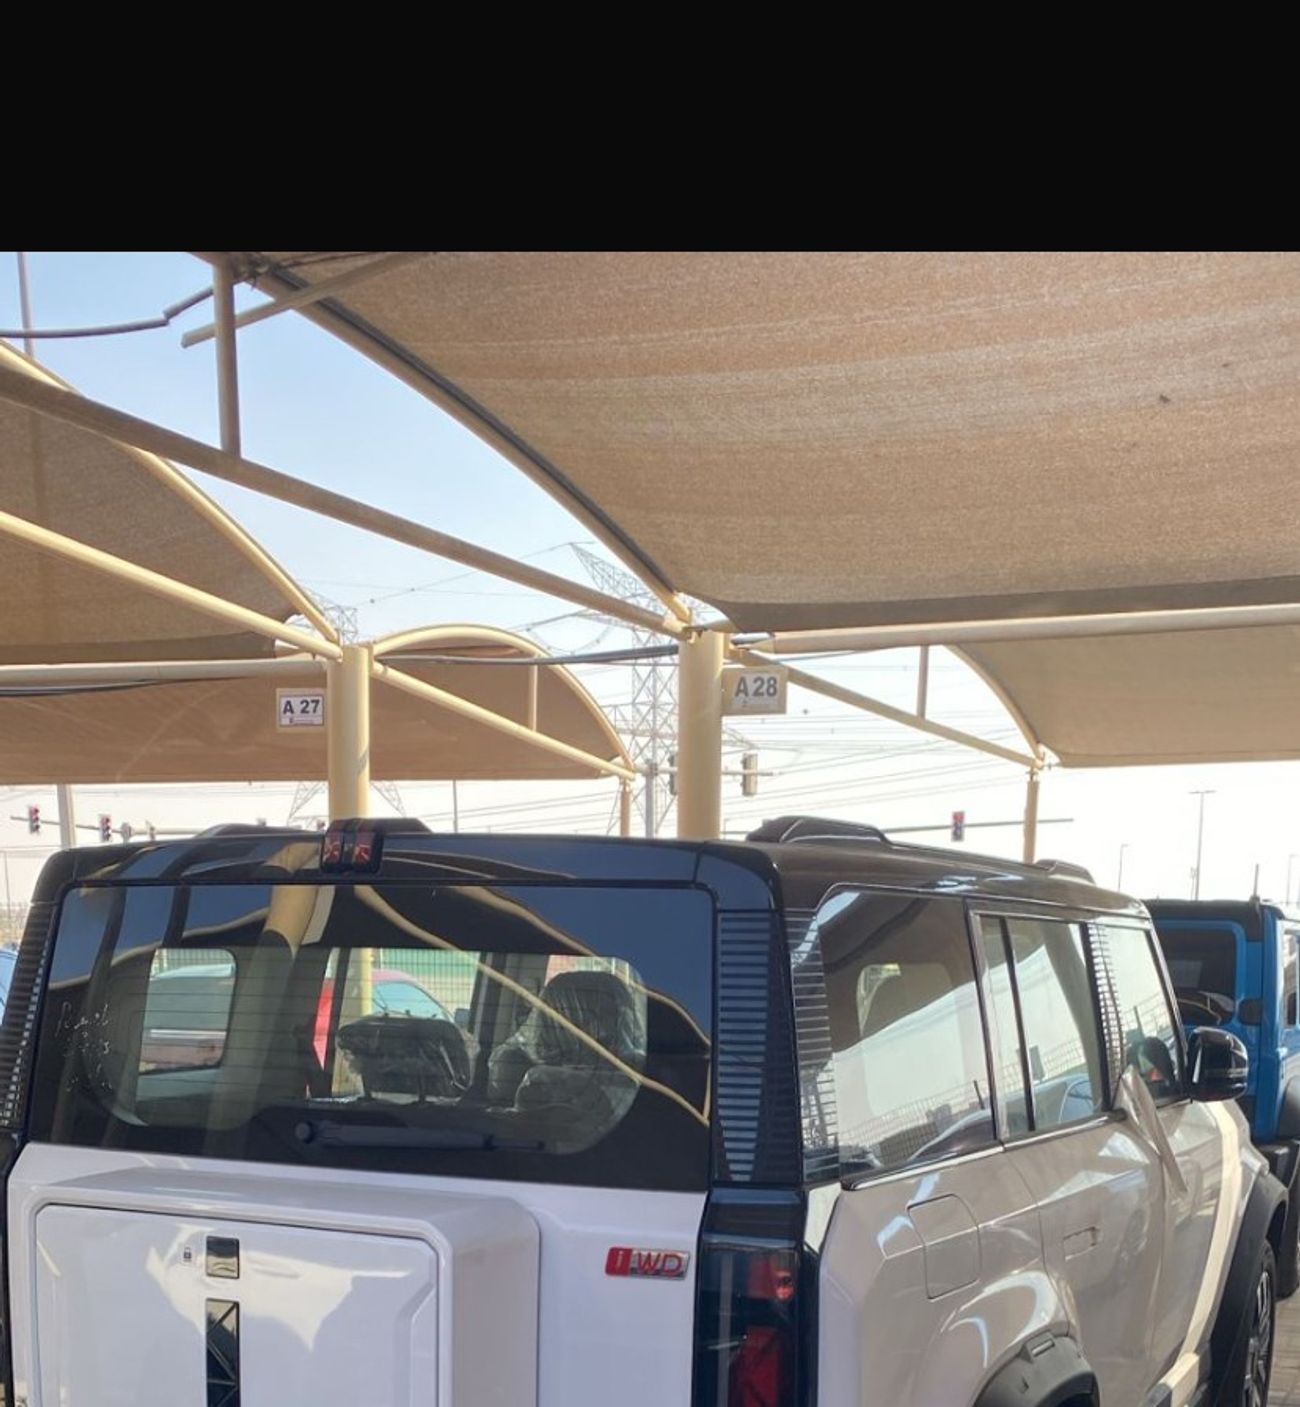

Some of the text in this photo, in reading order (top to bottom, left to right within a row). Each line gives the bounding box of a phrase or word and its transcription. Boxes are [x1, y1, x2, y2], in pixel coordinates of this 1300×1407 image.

[735, 676, 777, 697] A 28
[283, 699, 320, 714] A 27
